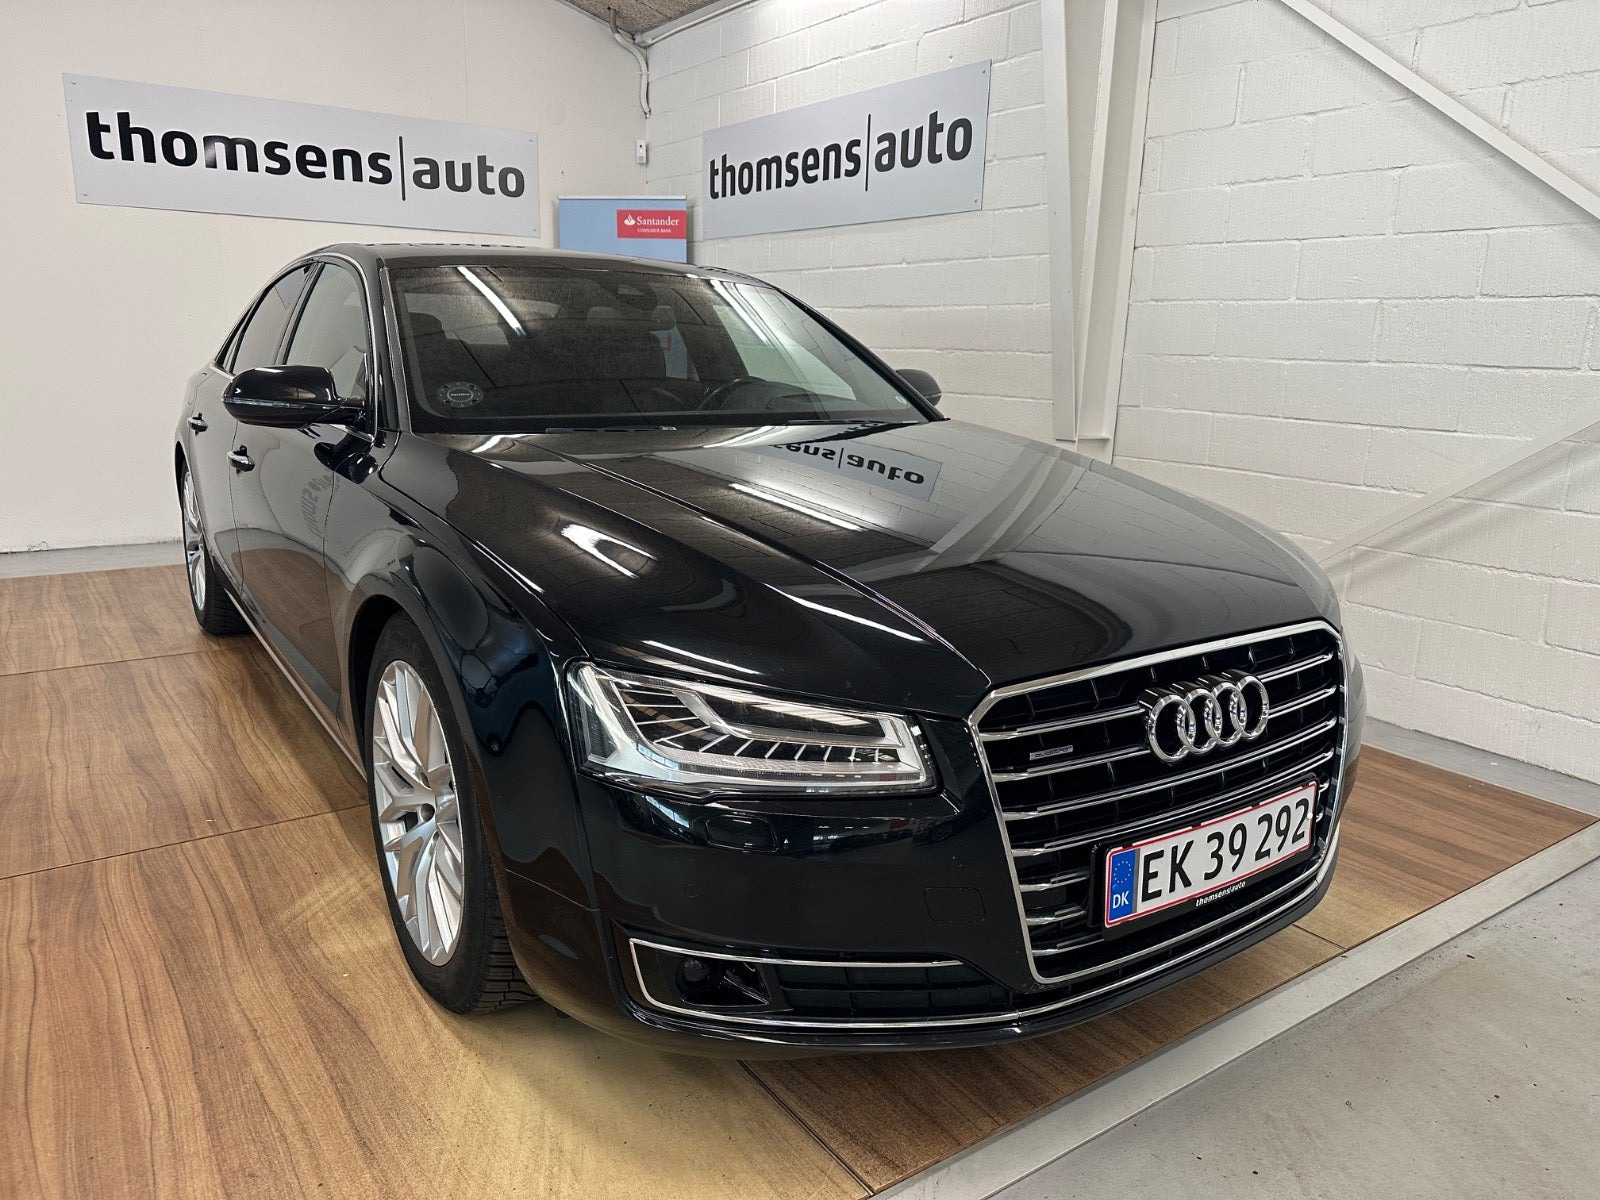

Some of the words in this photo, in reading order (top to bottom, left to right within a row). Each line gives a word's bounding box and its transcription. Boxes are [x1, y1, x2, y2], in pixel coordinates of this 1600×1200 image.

[636, 215, 680, 226] Santander
[1141, 839, 1195, 903] EK
[1203, 822, 1248, 881] 39
[1254, 797, 1310, 862] 292
[1112, 890, 1130, 909] DK
